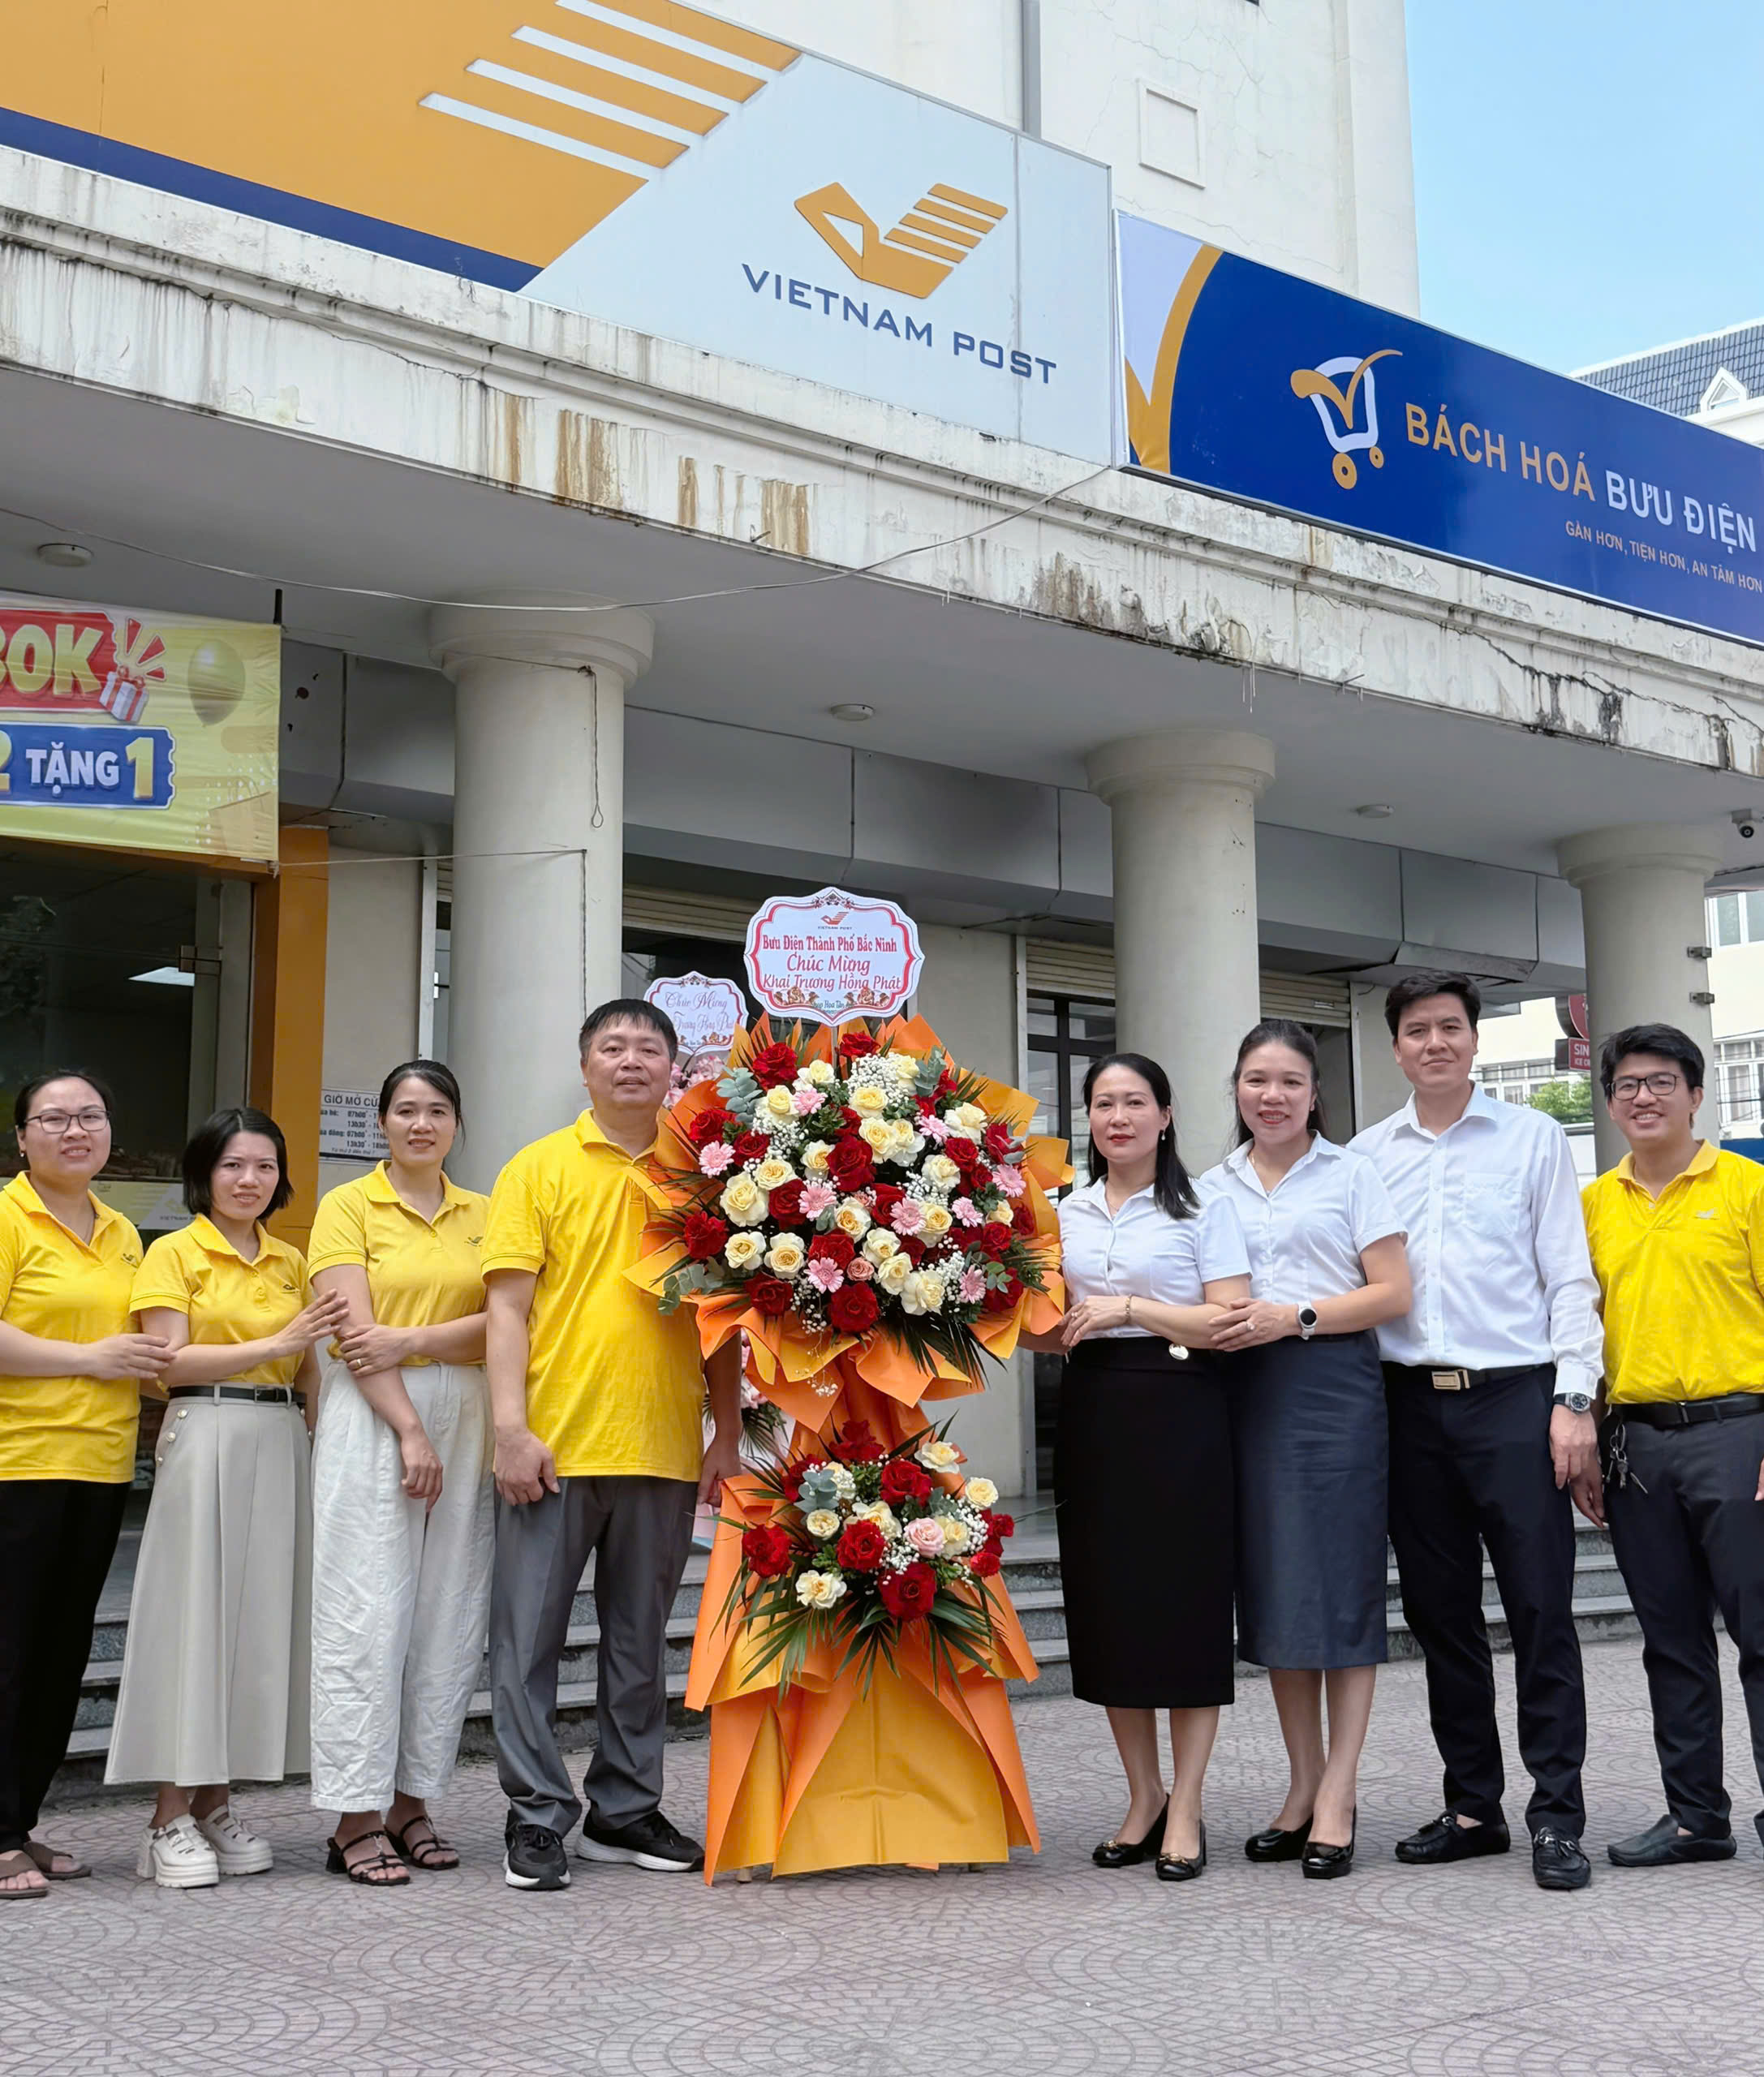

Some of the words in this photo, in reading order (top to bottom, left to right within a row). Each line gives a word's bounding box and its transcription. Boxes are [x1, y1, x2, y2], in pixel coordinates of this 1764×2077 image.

[742, 264, 932, 346] VIETNAM
[953, 331, 1056, 384] POST
[1406, 402, 1507, 473] BÁCH
[1520, 441, 1596, 501] HOÁ
[1606, 470, 1673, 527] BƯU
[1684, 496, 1757, 554] ĐIỆN
[1692, 560, 1708, 577] AN
[1710, 564, 1735, 584] TÂM
[1738, 573, 1763, 593] HƠN
[0, 624, 104, 695] OK
[26, 742, 120, 795] TẶNG
[126, 737, 154, 799] 1
[763, 935, 781, 949] Bưu
[783, 935, 804, 951] Điện
[807, 935, 835, 951] Thành
[837, 933, 855, 952] Phố
[857, 934, 872, 952] Bắc
[875, 936, 897, 952] Ninh
[787, 952, 824, 971] Chúc
[828, 955, 871, 975] Mừng
[763, 974, 790, 988] Khai
[794, 974, 835, 991] Trương
[838, 972, 869, 991] Hồng
[873, 975, 901, 989] Phát
[324, 1093, 342, 1104] GIỜ
[345, 1094, 361, 1105] MỞ
[364, 1095, 378, 1107] CỬ
